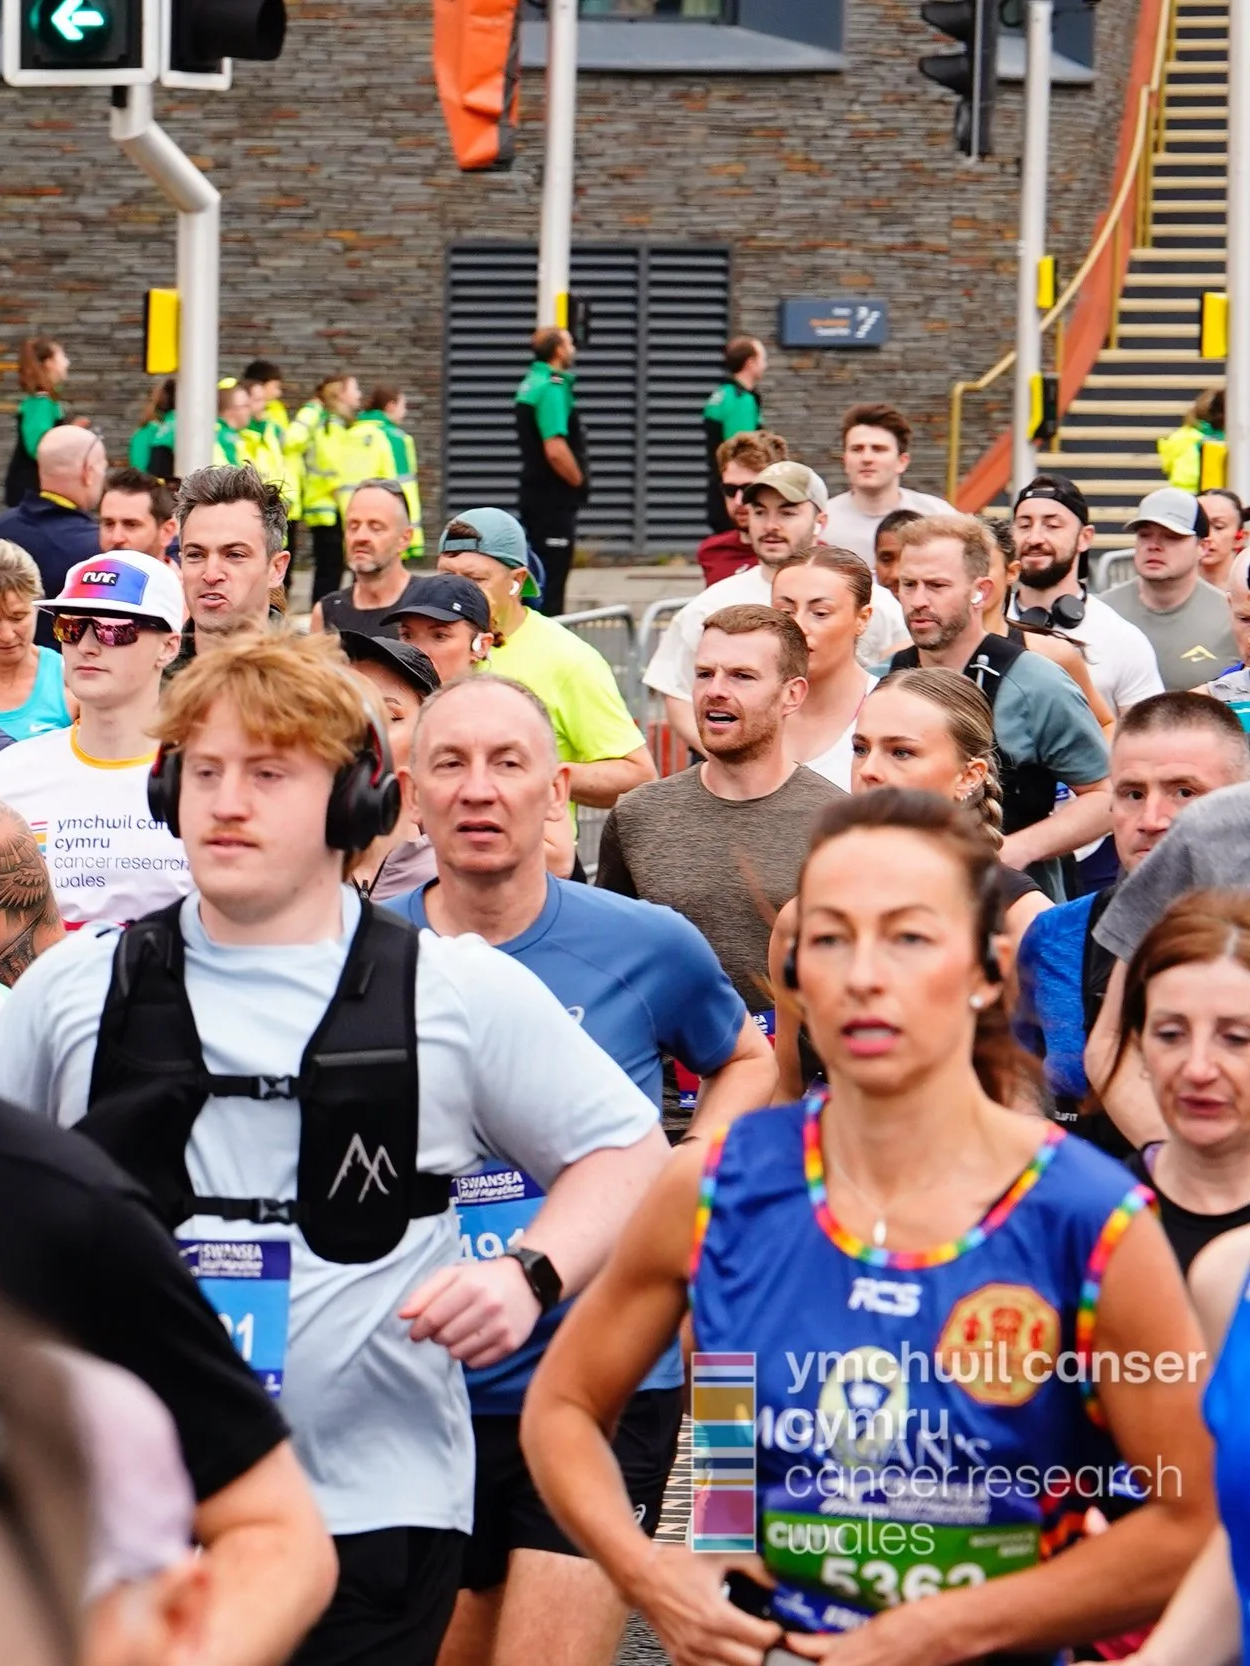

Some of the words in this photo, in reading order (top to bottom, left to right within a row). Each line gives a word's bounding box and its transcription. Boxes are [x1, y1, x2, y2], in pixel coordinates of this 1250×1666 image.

[57, 814, 132, 832] ymchwil
[136, 818, 170, 830] can
[54, 836, 111, 851] cymru
[54, 855, 111, 870] cancer
[115, 856, 191, 871] research
[54, 873, 106, 889] wales
[460, 1171, 523, 1189] SWANSEA
[480, 1183, 525, 1197] Marathon
[203, 1243, 263, 1260] SWANSEA
